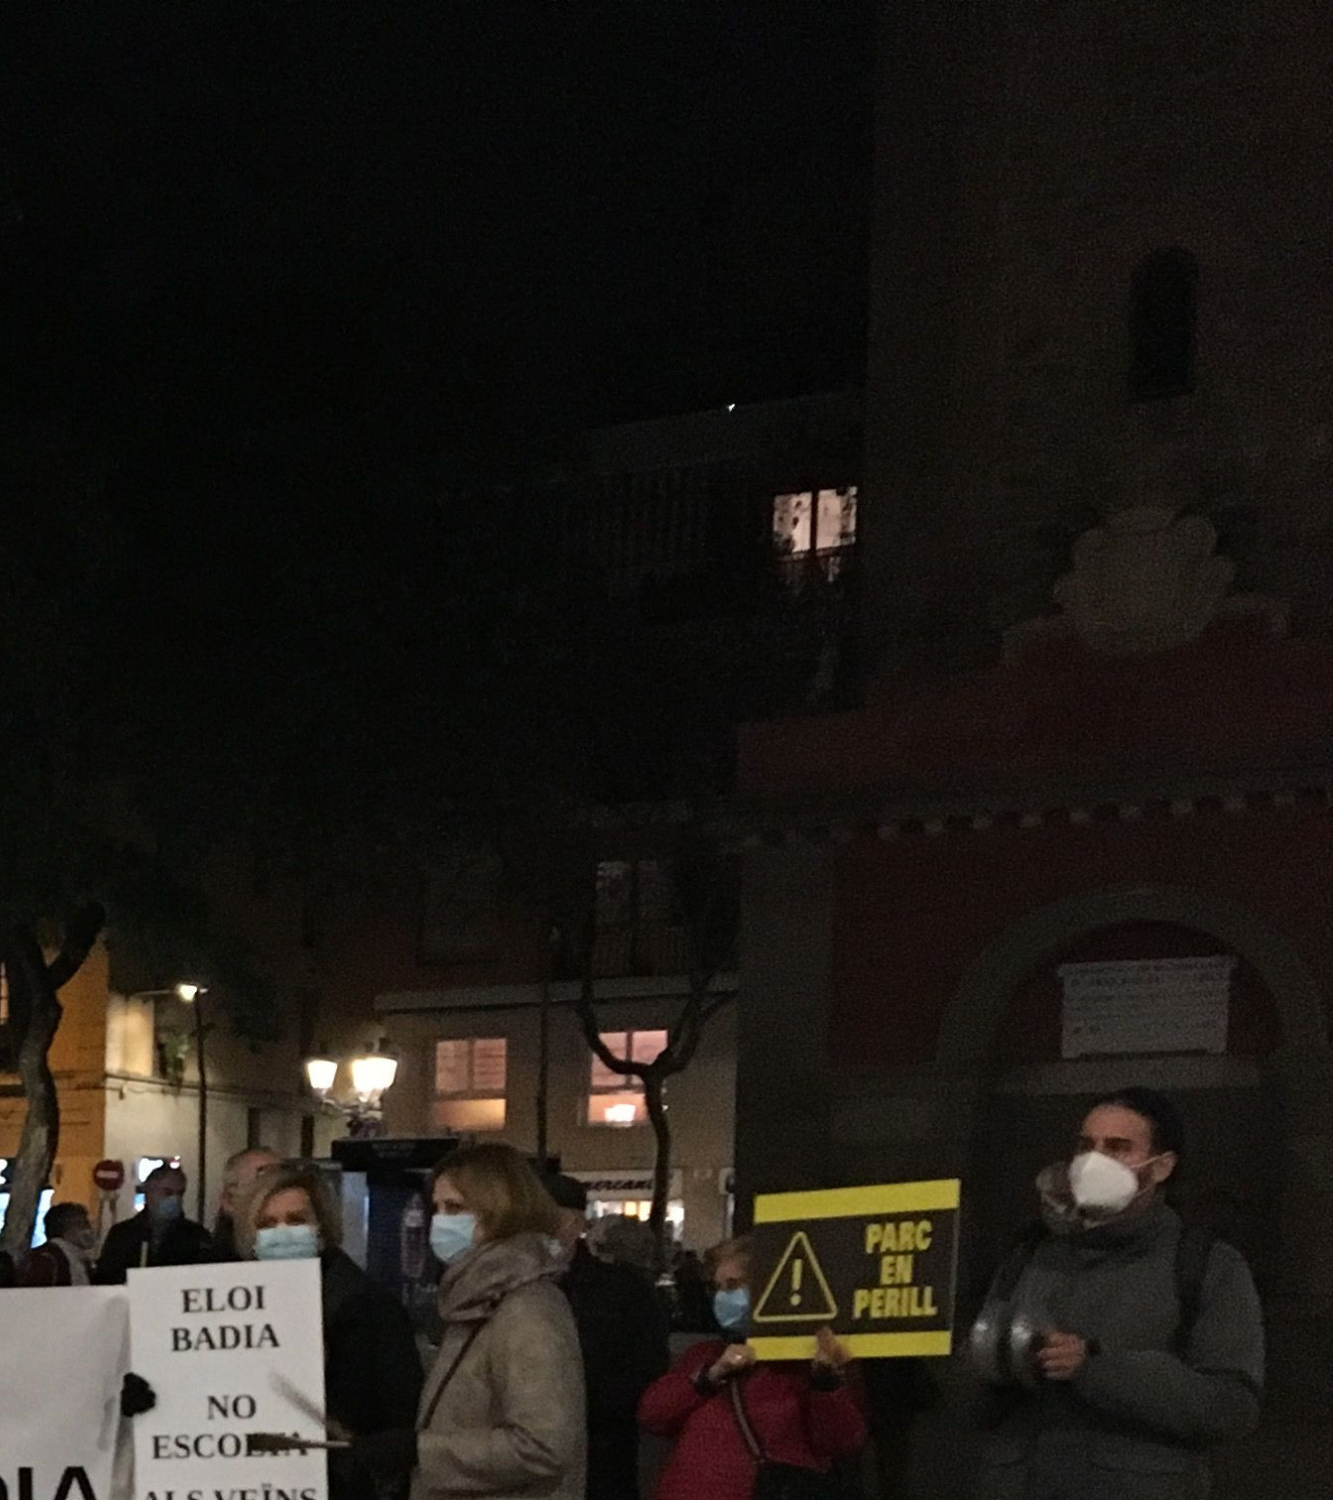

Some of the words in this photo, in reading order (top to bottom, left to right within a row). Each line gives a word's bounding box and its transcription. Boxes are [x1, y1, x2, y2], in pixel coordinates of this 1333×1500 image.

[865, 1220, 933, 1255] PARC
[880, 1254, 914, 1285] EN
[181, 1285, 265, 1314] ELOI
[853, 1286, 939, 1319] PERILL
[170, 1323, 280, 1352] BADIA
[207, 1394, 257, 1420] NO
